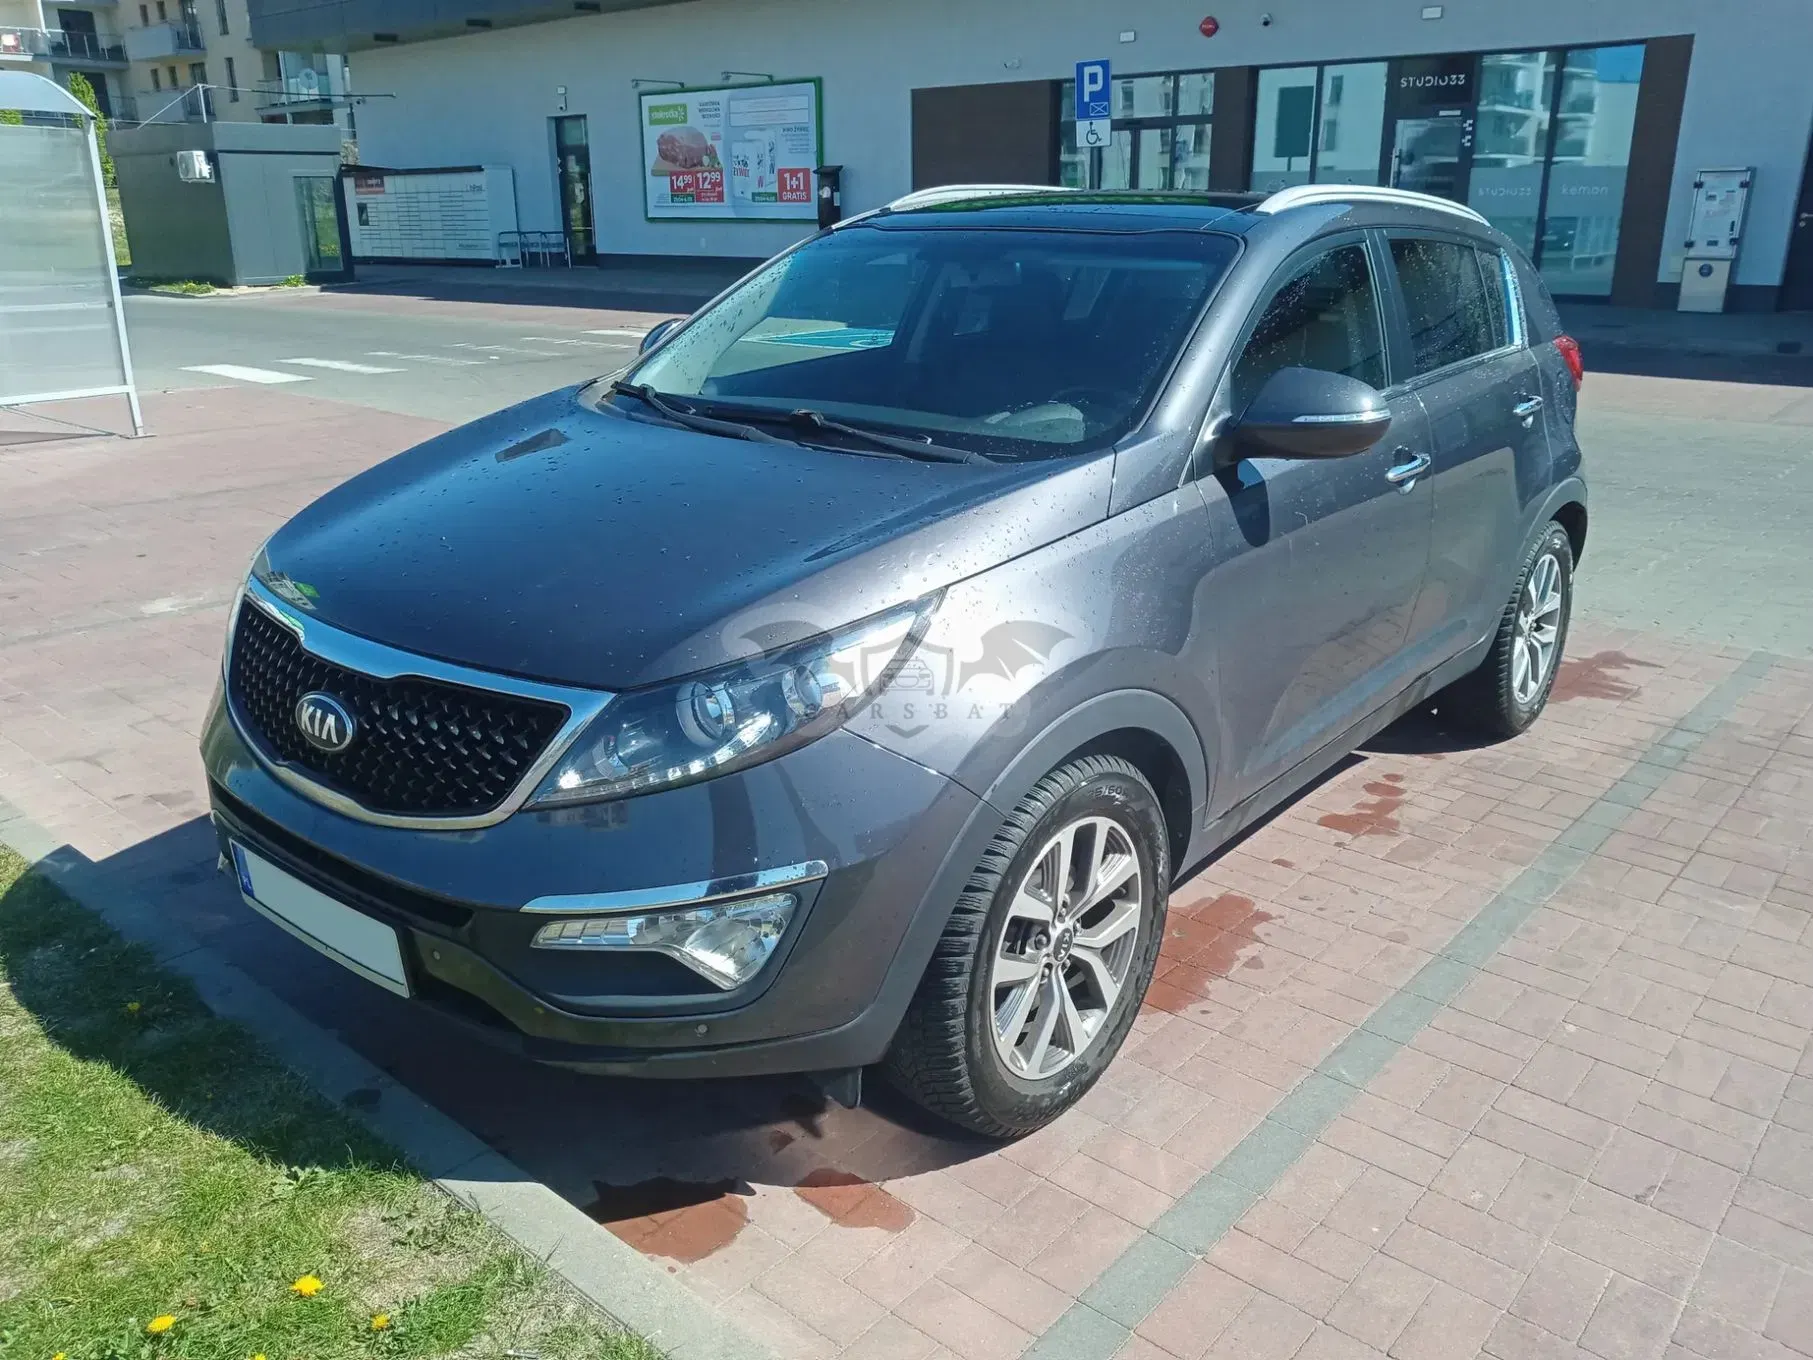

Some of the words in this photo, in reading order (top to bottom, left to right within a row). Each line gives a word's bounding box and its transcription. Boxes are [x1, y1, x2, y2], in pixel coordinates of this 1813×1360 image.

[1083, 66, 1103, 102] P
[784, 172, 804, 189] 1+1
[1560, 184, 1609, 196] kemon
[782, 192, 807, 201] GRATIS
[301, 703, 338, 744] KIA
[1058, 932, 1070, 961] KIA
